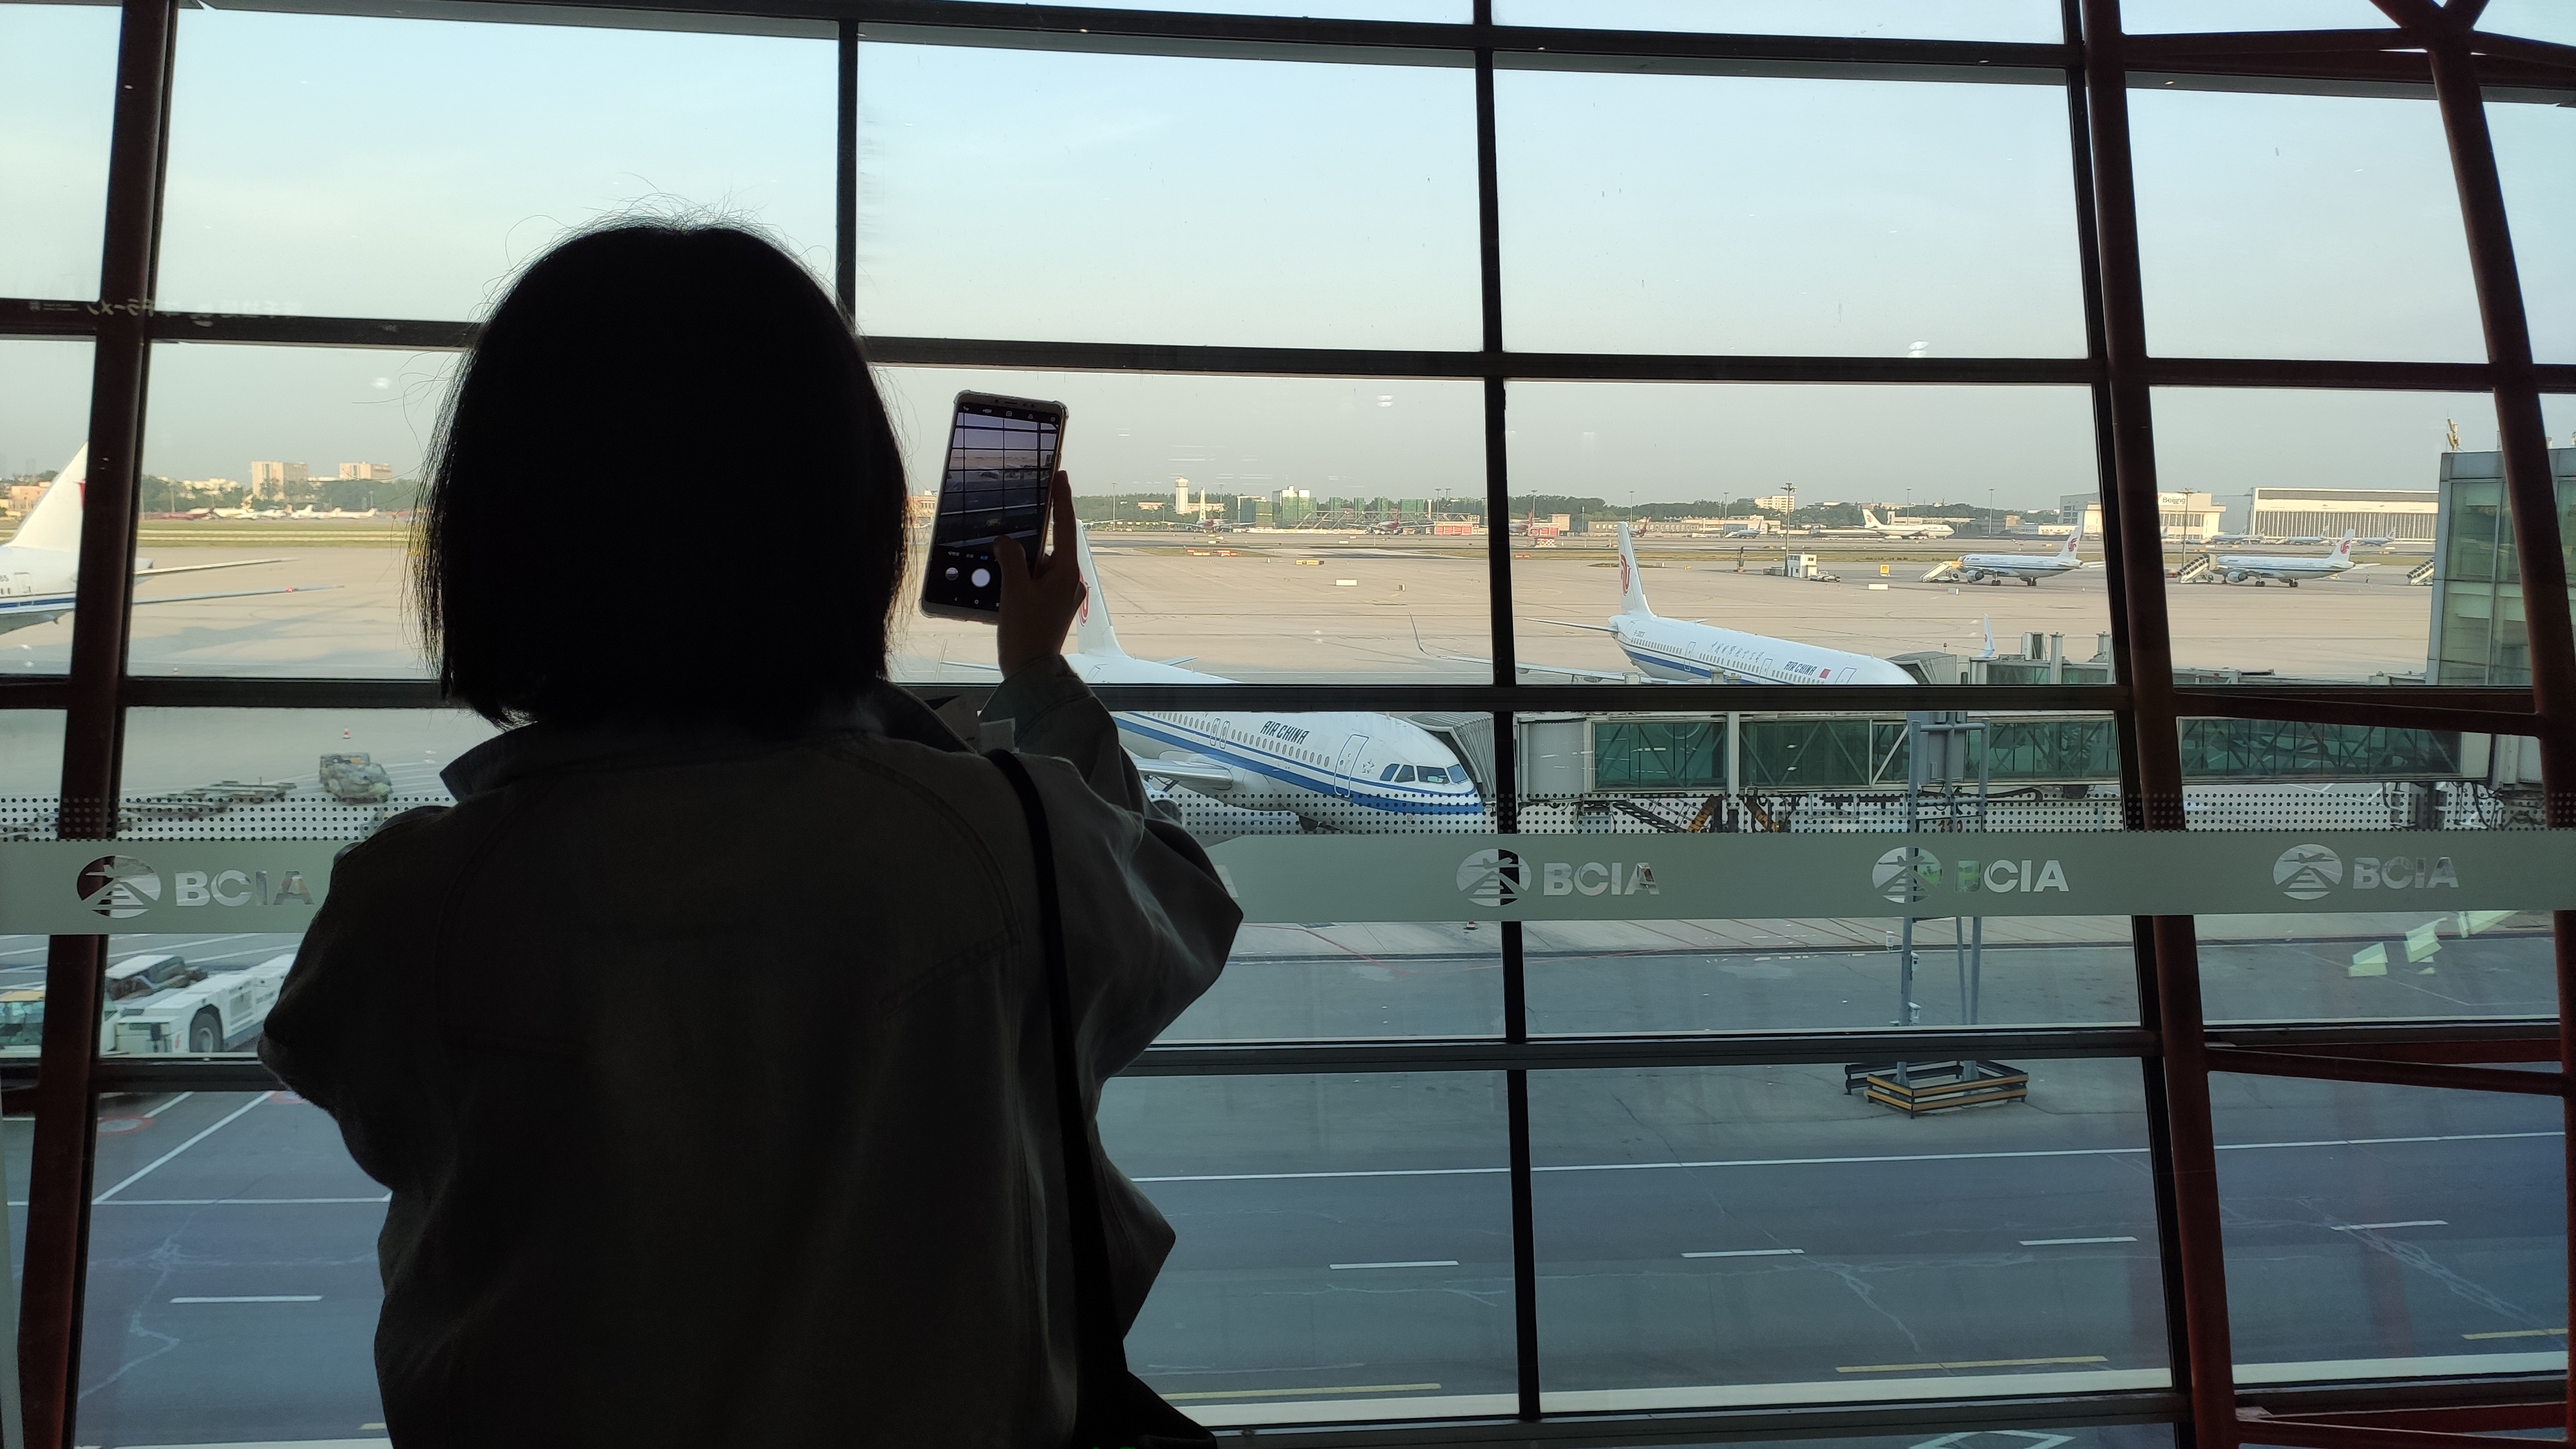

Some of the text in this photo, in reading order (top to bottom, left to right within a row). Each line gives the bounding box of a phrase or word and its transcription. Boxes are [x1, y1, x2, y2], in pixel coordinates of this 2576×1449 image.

[1783, 661, 1817, 676] AIR CHINA
[1260, 721, 1311, 744] AIR CHINA
[175, 869, 314, 907] BCIA
[1544, 862, 1660, 896] BCIA
[1954, 860, 2069, 893] BCIA
[2353, 856, 2459, 890] BCIA
